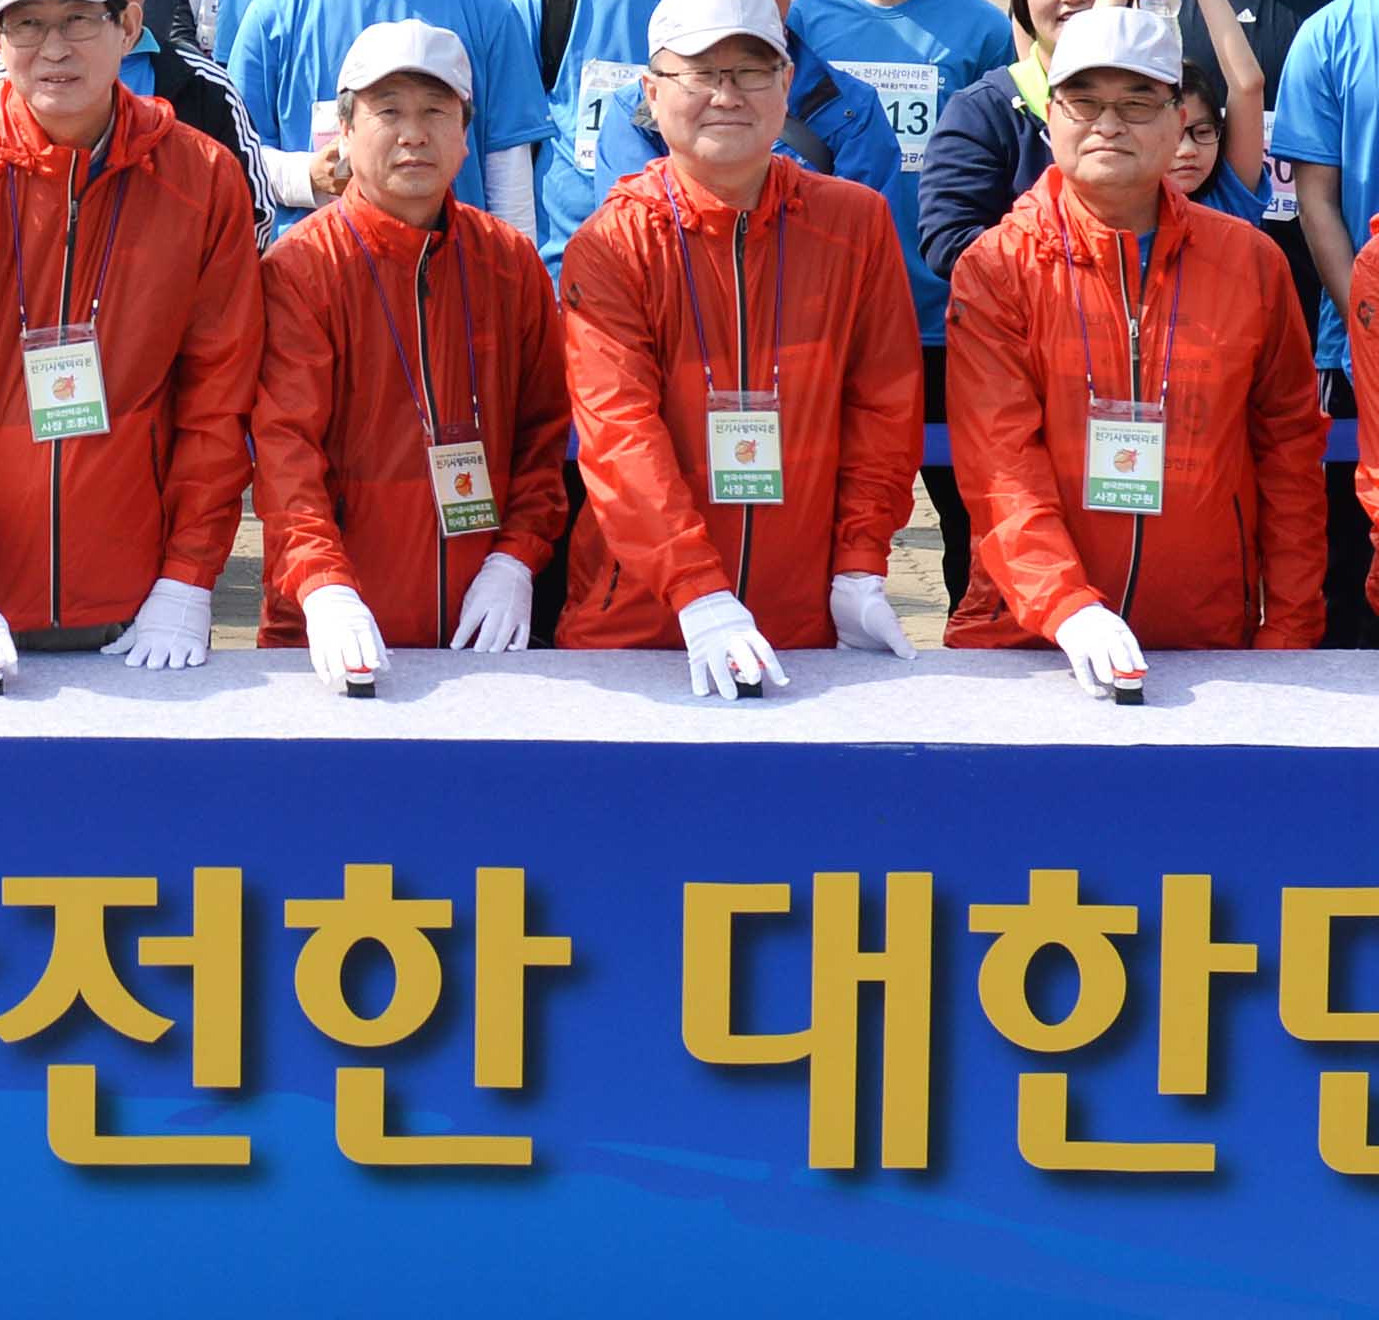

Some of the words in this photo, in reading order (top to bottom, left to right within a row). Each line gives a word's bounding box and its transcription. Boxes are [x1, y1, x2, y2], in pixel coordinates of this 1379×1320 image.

[863, 66, 932, 82] 전기사랑마라톤
[30, 357, 93, 375] 전기사랑마라톤
[41, 419, 63, 433] 사장
[715, 422, 777, 435] 전기사랑마라톤
[1095, 431, 1161, 446] 전기사랑마라톤
[435, 454, 484, 470] 전기사랑마라톤
[722, 483, 744, 496] 사장
[1094, 491, 1118, 504] 사장
